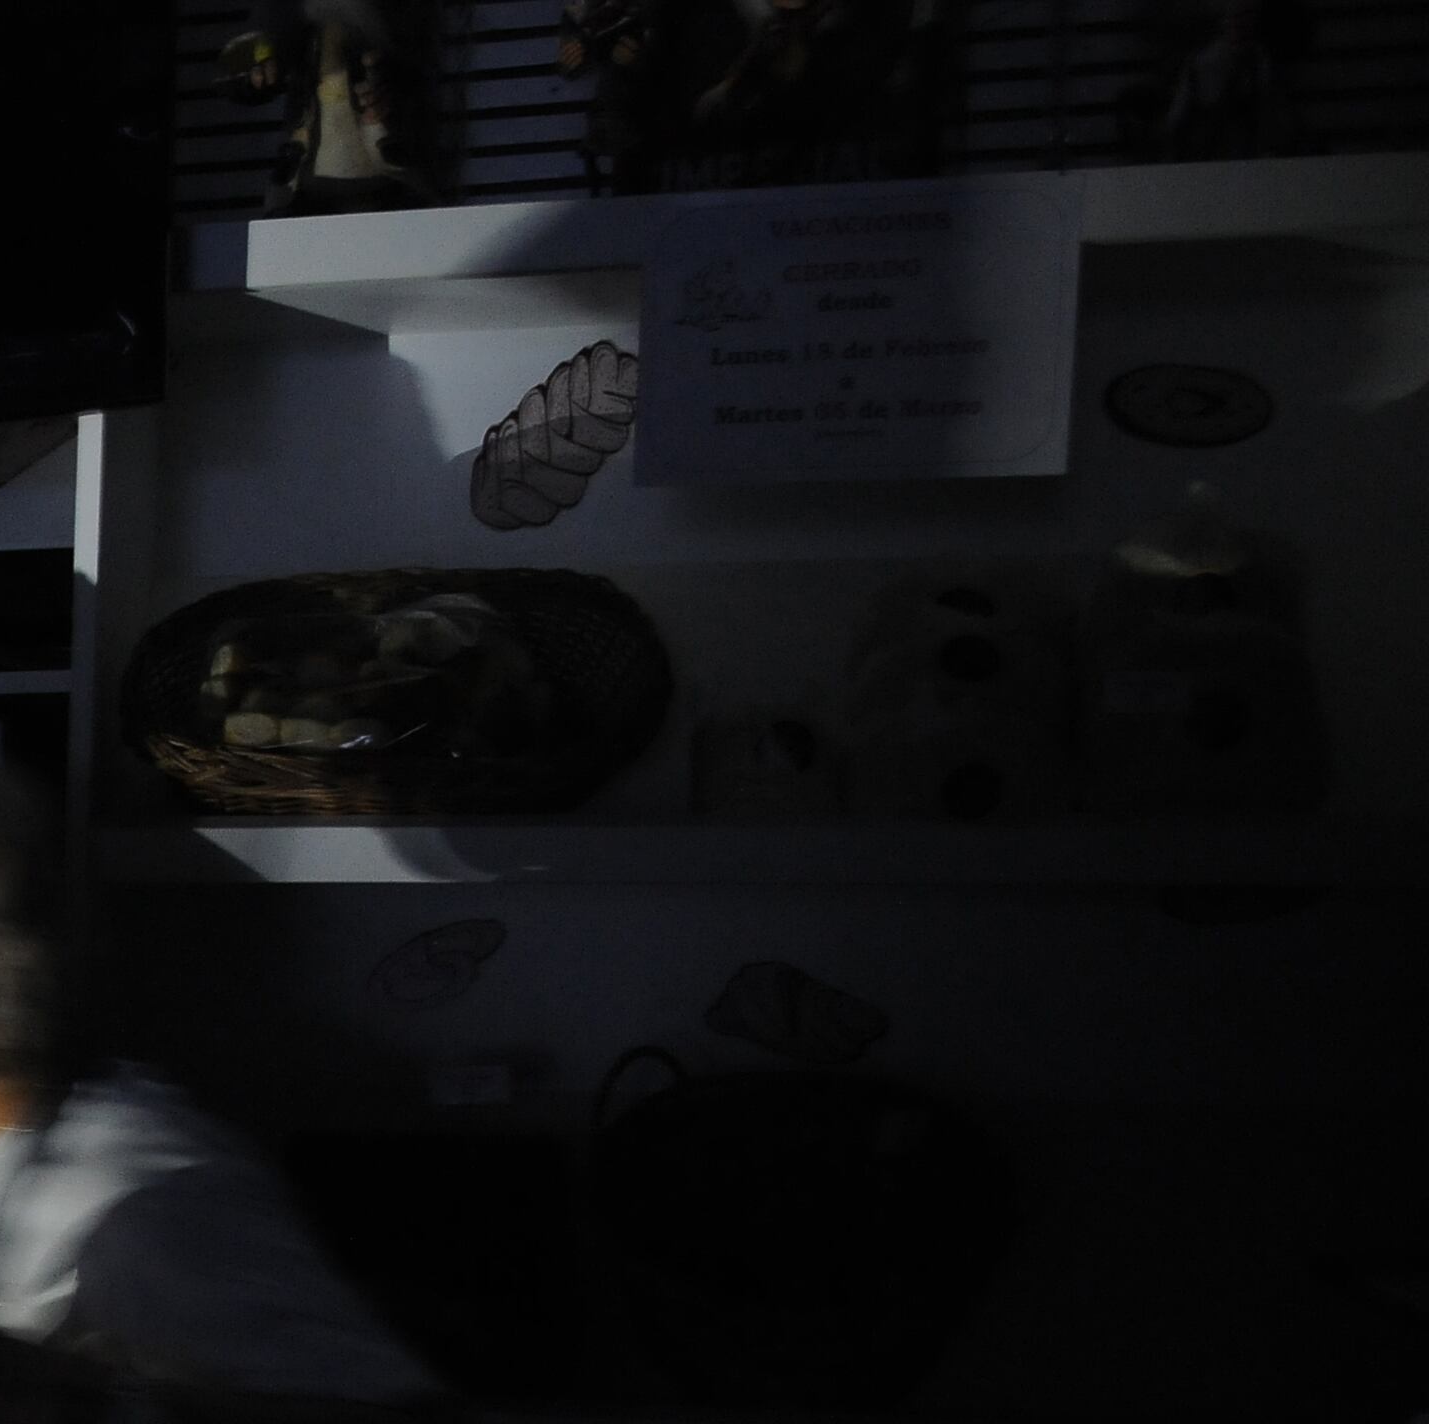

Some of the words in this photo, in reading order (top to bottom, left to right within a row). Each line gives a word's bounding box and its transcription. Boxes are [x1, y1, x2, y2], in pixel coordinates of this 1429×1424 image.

[769, 212, 952, 238] VACACIONES
[783, 259, 920, 282] CERRADO
[818, 291, 893, 312] desde
[710, 347, 789, 366] Lunes
[843, 341, 873, 360] de
[885, 338, 990, 357] Febrero
[838, 376, 855, 390] a
[715, 405, 804, 425] Martes
[859, 400, 889, 419] de
[900, 398, 982, 417] Marzo
